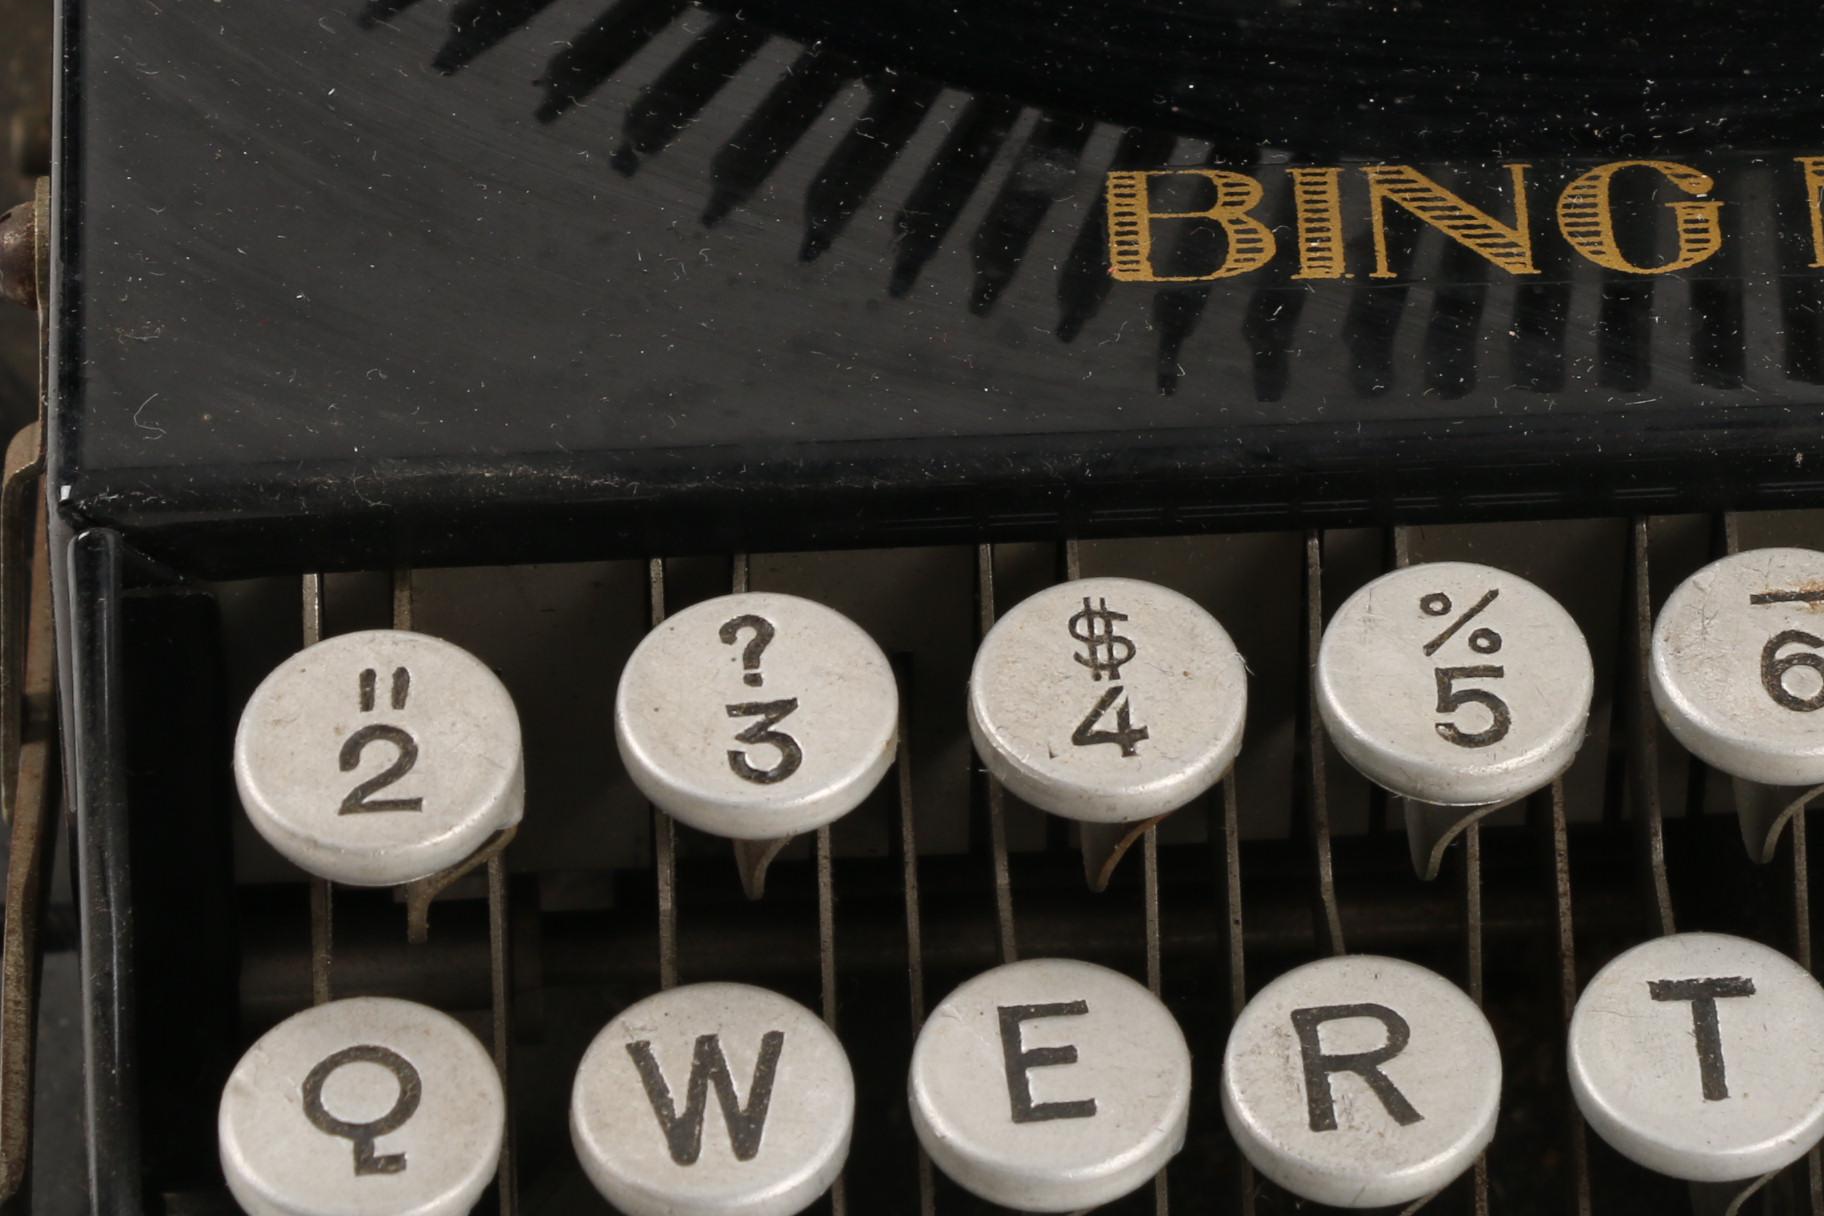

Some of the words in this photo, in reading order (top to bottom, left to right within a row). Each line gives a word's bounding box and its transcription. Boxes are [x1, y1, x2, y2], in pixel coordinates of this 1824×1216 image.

[1106, 160, 1723, 282] BING
[719, 615, 774, 687] ?
[1068, 597, 1136, 681] $
[1420, 589, 1502, 656] %
[726, 698, 802, 785] 3
[1072, 686, 1149, 757] 4
[1435, 665, 1511, 748] 5
[338, 724, 423, 815] 2
[997, 1000, 1096, 1123] E
[1291, 1003, 1424, 1132] R
[1647, 976, 1756, 1101] T
[302, 1045, 422, 1176] Q
[626, 1031, 784, 1166] W
